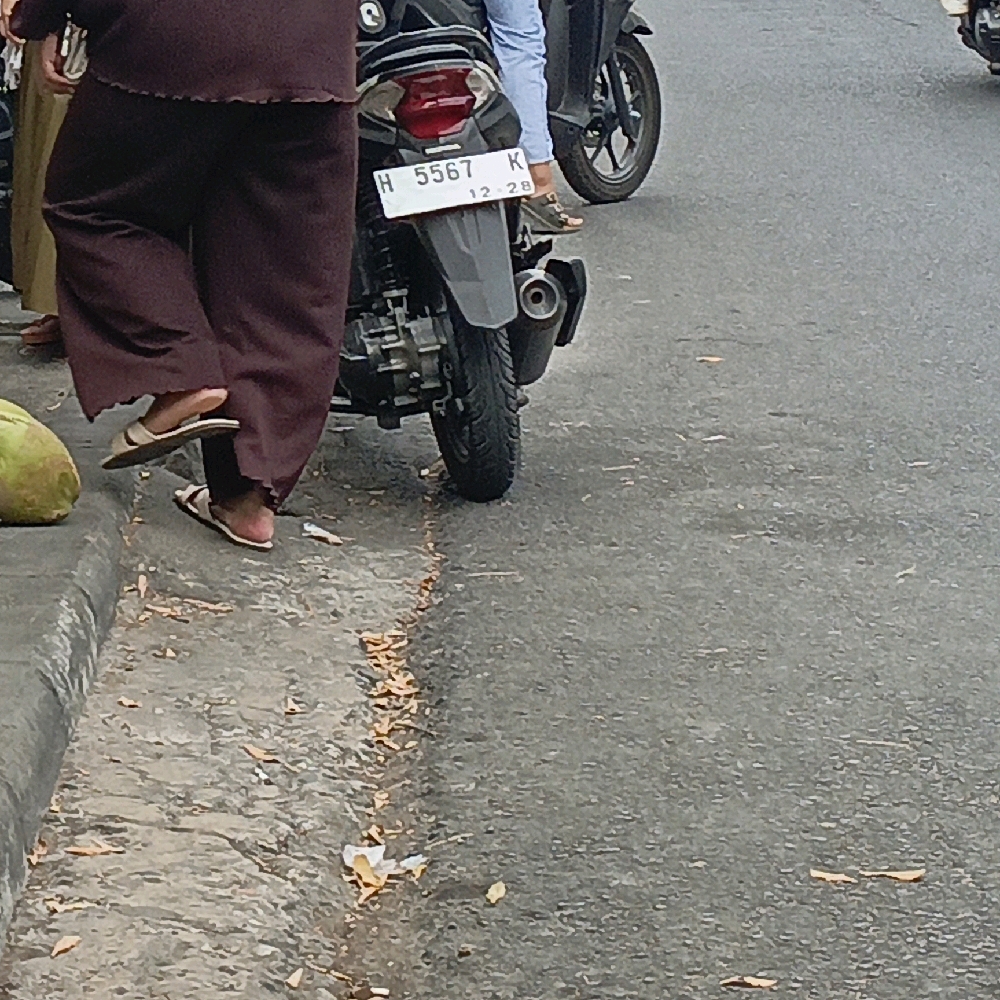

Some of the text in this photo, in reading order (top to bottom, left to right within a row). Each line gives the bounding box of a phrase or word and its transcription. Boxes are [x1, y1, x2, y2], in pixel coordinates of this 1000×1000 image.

[377, 150, 525, 194] H 5567 K
